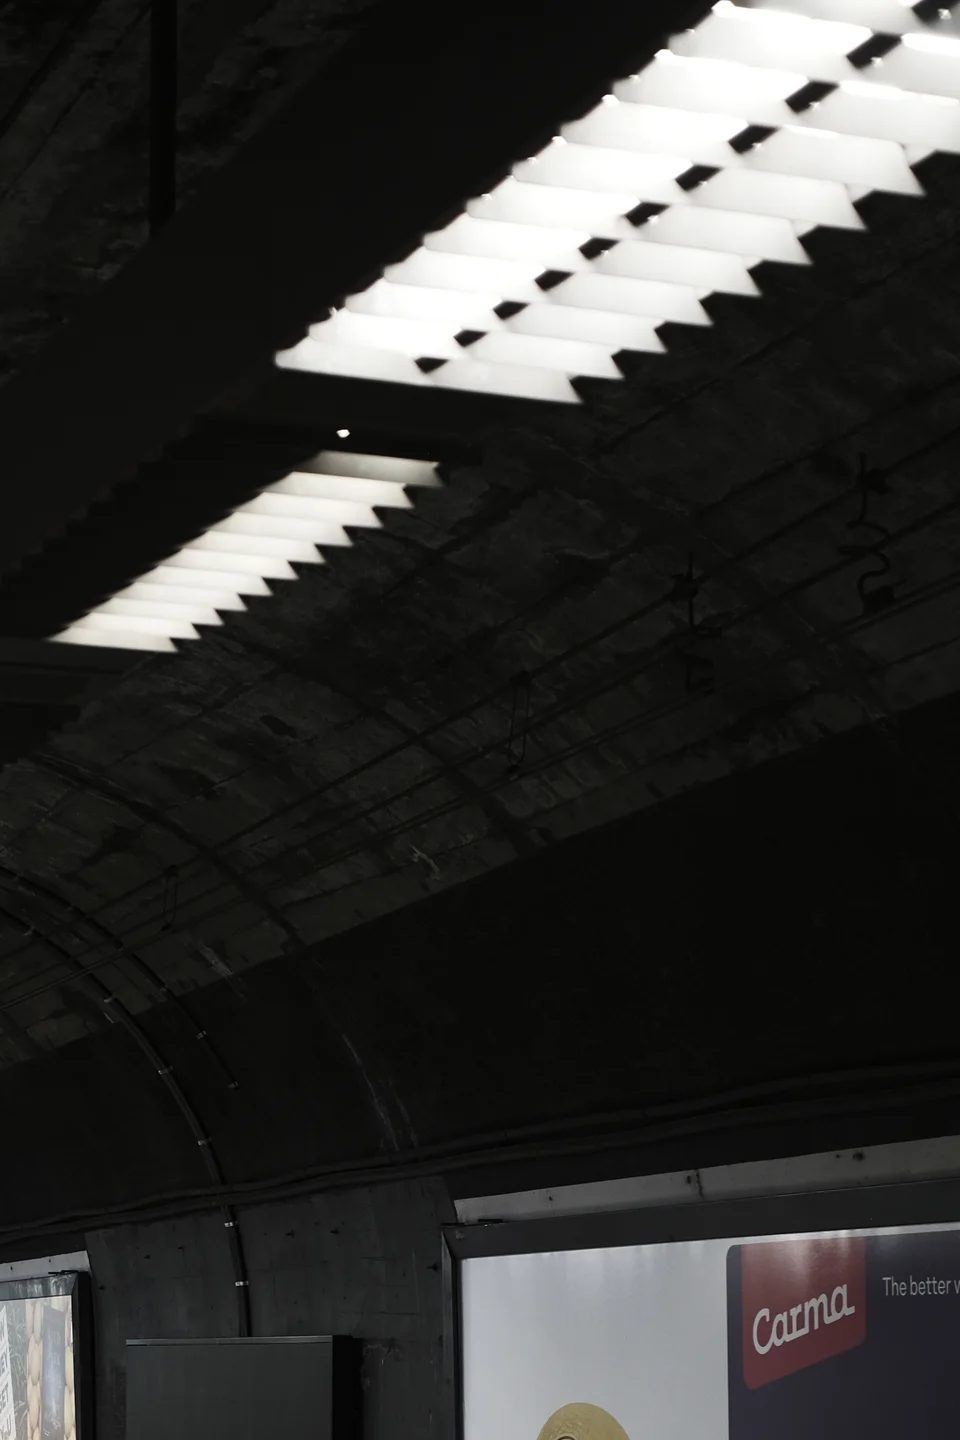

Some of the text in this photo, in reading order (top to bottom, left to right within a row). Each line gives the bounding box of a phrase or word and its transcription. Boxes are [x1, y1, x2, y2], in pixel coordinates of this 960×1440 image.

[882, 1277, 907, 1296] The
[909, 1275, 951, 1296] better
[752, 1284, 855, 1354] Carma
